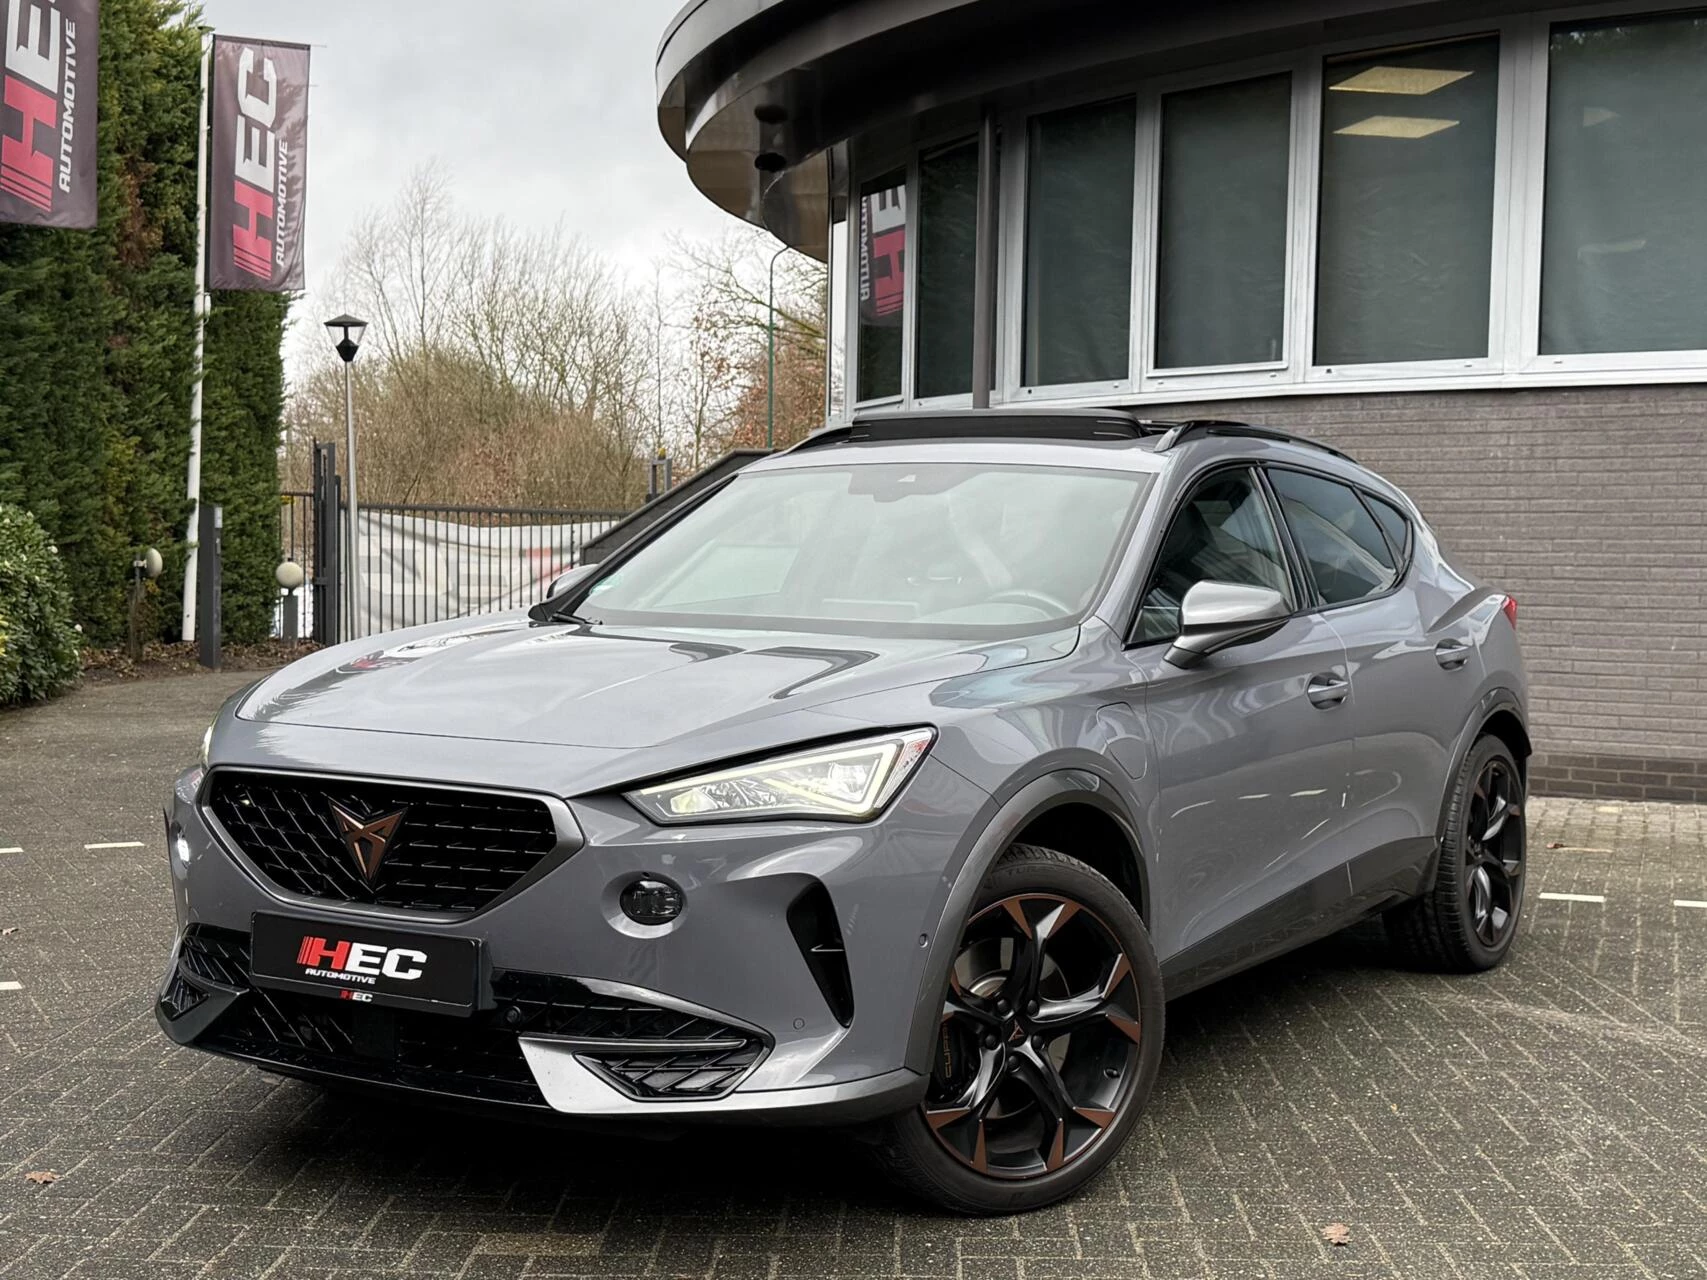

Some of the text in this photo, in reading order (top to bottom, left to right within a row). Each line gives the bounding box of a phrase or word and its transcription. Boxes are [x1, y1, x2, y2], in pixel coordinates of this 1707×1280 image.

[0, 0, 61, 213] HE
[58, 18, 77, 194] AUTOMOTIVE
[232, 46, 278, 281] HEC
[275, 139, 289, 267] AUTOMOTIVE
[296, 935, 428, 981] HEC
[304, 967, 377, 985] AUTOMOTIVE
[340, 989, 374, 1003] HEC
